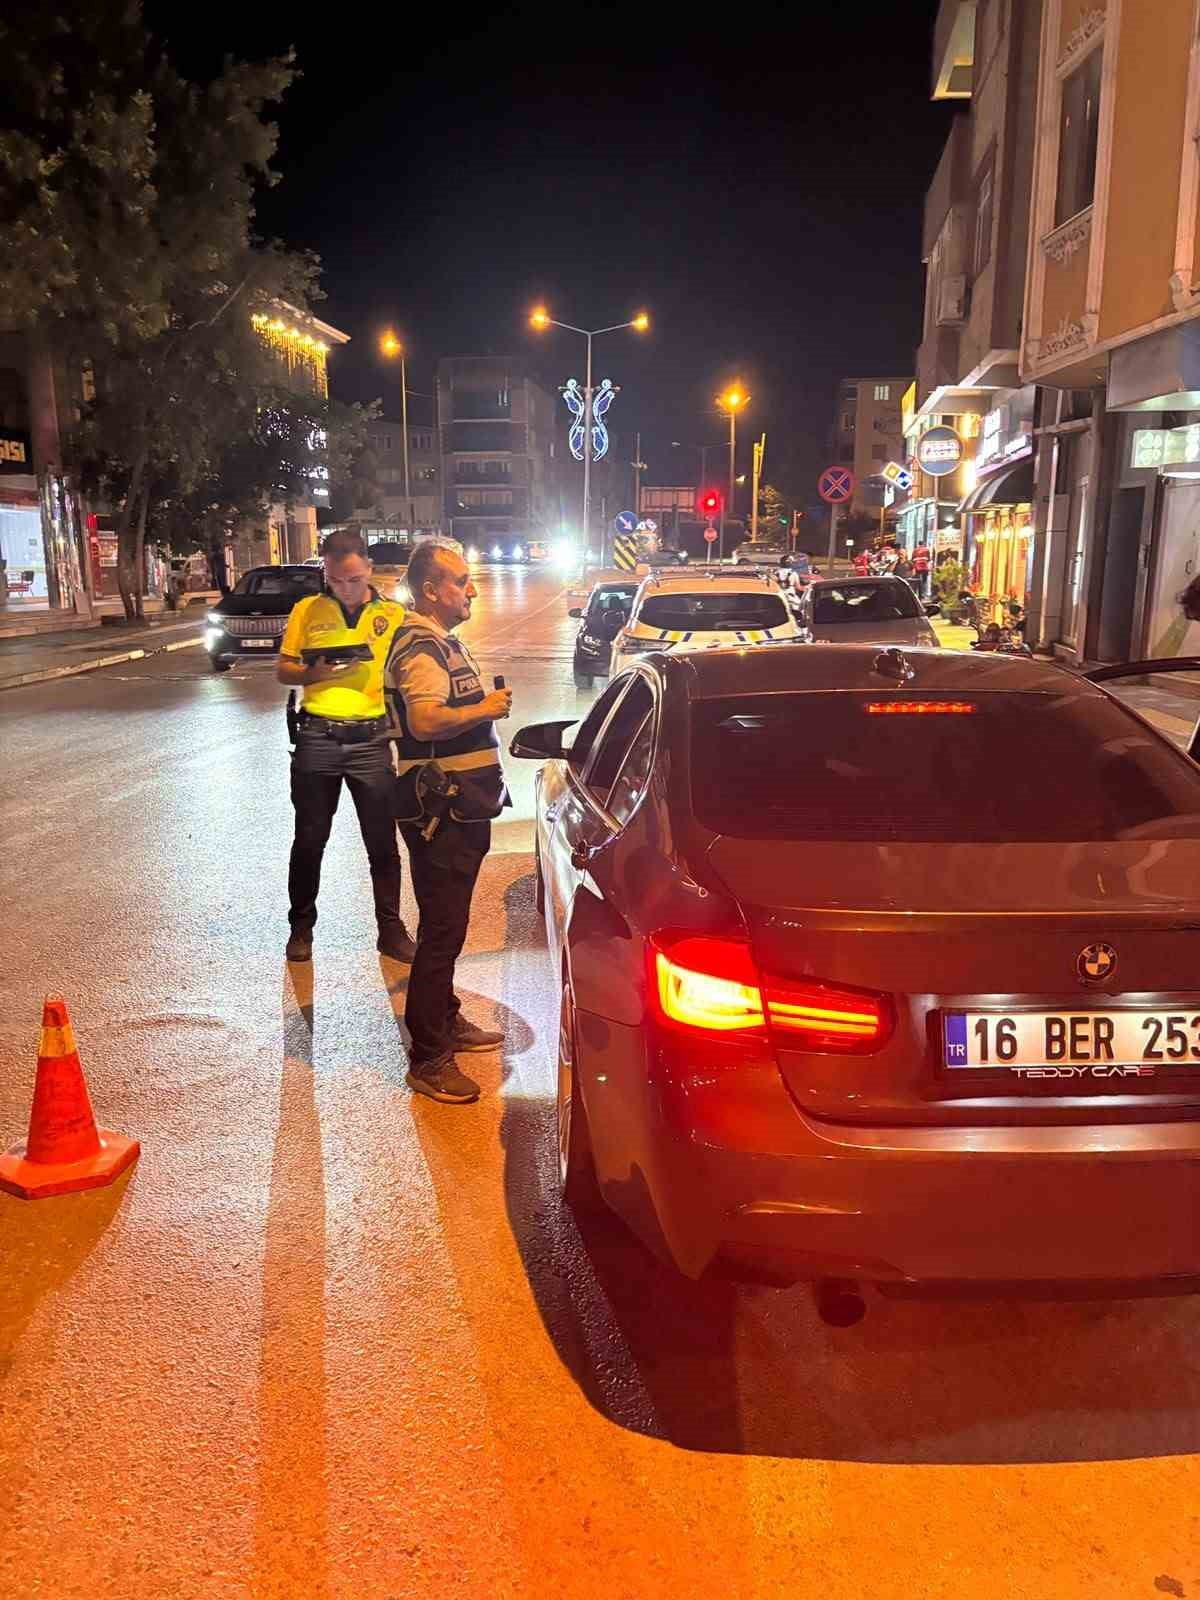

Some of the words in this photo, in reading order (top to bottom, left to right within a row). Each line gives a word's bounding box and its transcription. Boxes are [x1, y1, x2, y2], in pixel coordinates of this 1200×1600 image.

[974, 1017, 1017, 1061] 16
[1045, 1016, 1115, 1060] BER
[948, 1043, 966, 1057] TR
[1011, 1066, 1089, 1079] TEDDY
